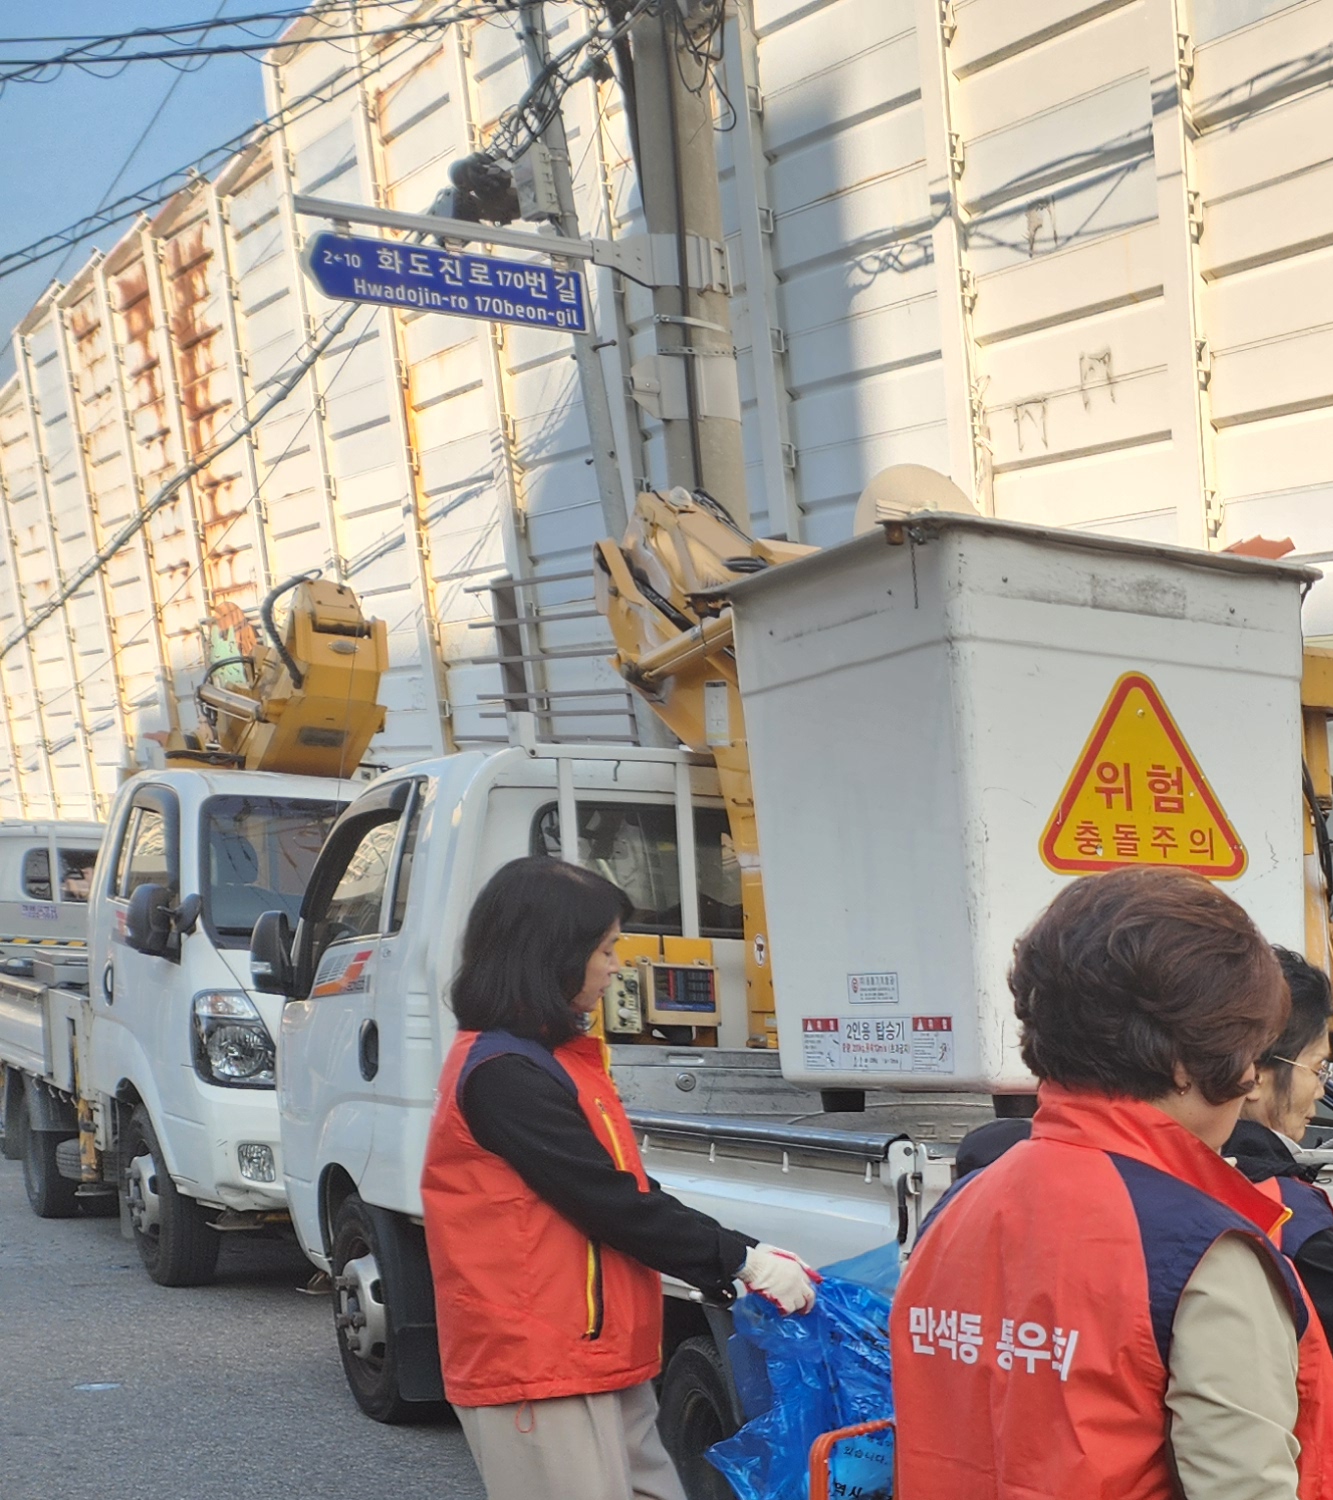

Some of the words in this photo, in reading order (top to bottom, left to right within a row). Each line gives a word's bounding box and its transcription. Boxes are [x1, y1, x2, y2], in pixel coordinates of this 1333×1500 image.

[354, 279, 468, 310] Hwadojin-ro
[475, 296, 579, 327] 170beon-gil
[1094, 761, 1185, 814] 위험
[1074, 820, 1215, 861] 충돌주의
[846, 1021, 871, 1041] 2인용
[875, 1020, 905, 1041] 탑승기
[909, 1306, 984, 1364] 만석동
[996, 1318, 1079, 1381] 통우회
